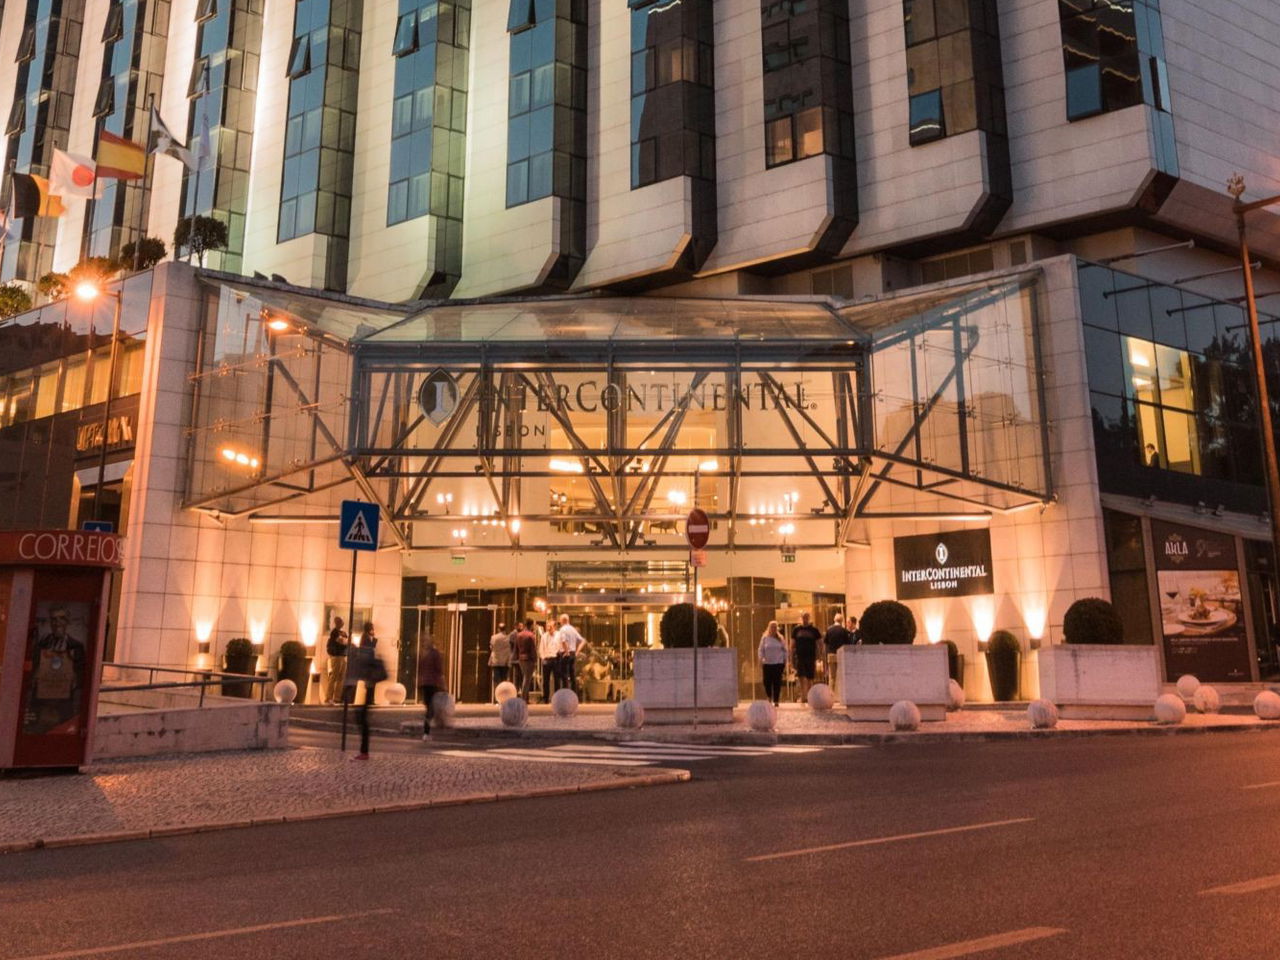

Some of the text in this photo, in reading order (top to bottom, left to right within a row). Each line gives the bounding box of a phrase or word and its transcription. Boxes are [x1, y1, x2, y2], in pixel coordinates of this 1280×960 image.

[477, 380, 809, 413] NTERCONTINENTAL
[476, 424, 545, 437] LSBON
[18, 532, 122, 563] CORREIOS
[902, 565, 987, 582] INTERCONTINENTAL
[930, 580, 958, 589] LISBON
